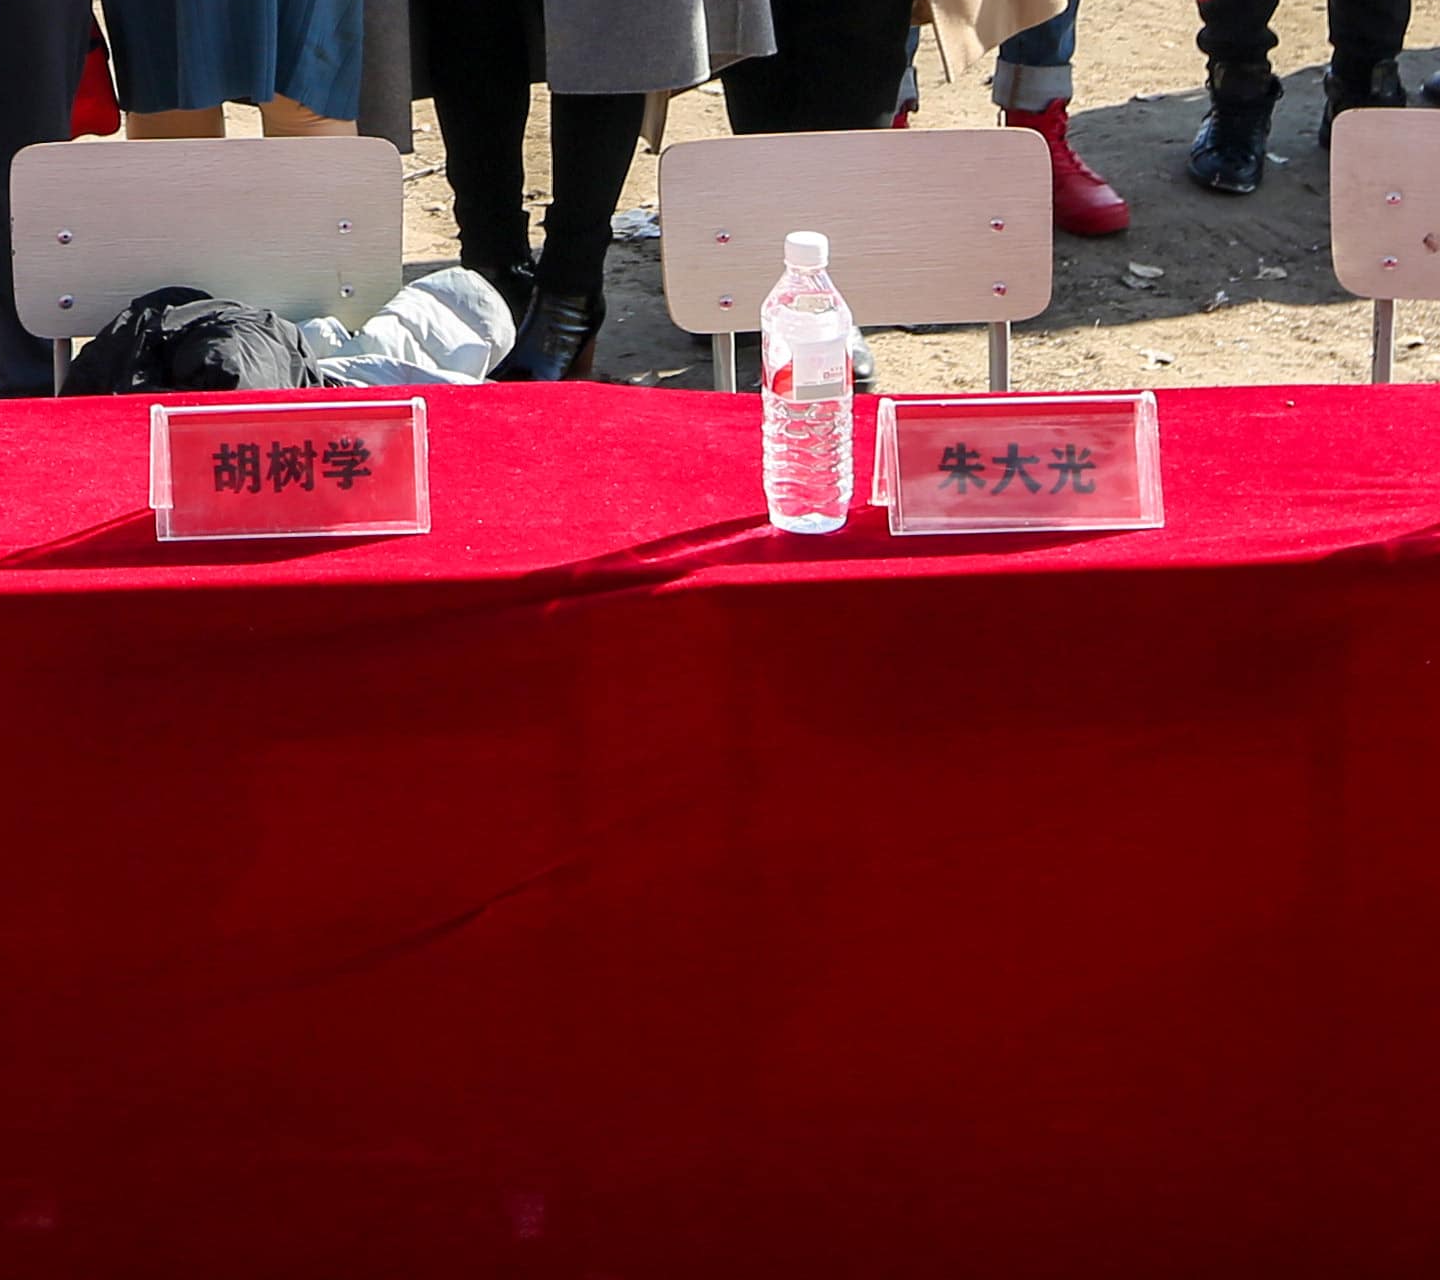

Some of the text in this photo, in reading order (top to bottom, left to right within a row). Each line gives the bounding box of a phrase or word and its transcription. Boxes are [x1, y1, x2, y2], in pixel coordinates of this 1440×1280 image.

[212, 437, 372, 494] 胡树学
[938, 442, 1096, 495] 朱大光
